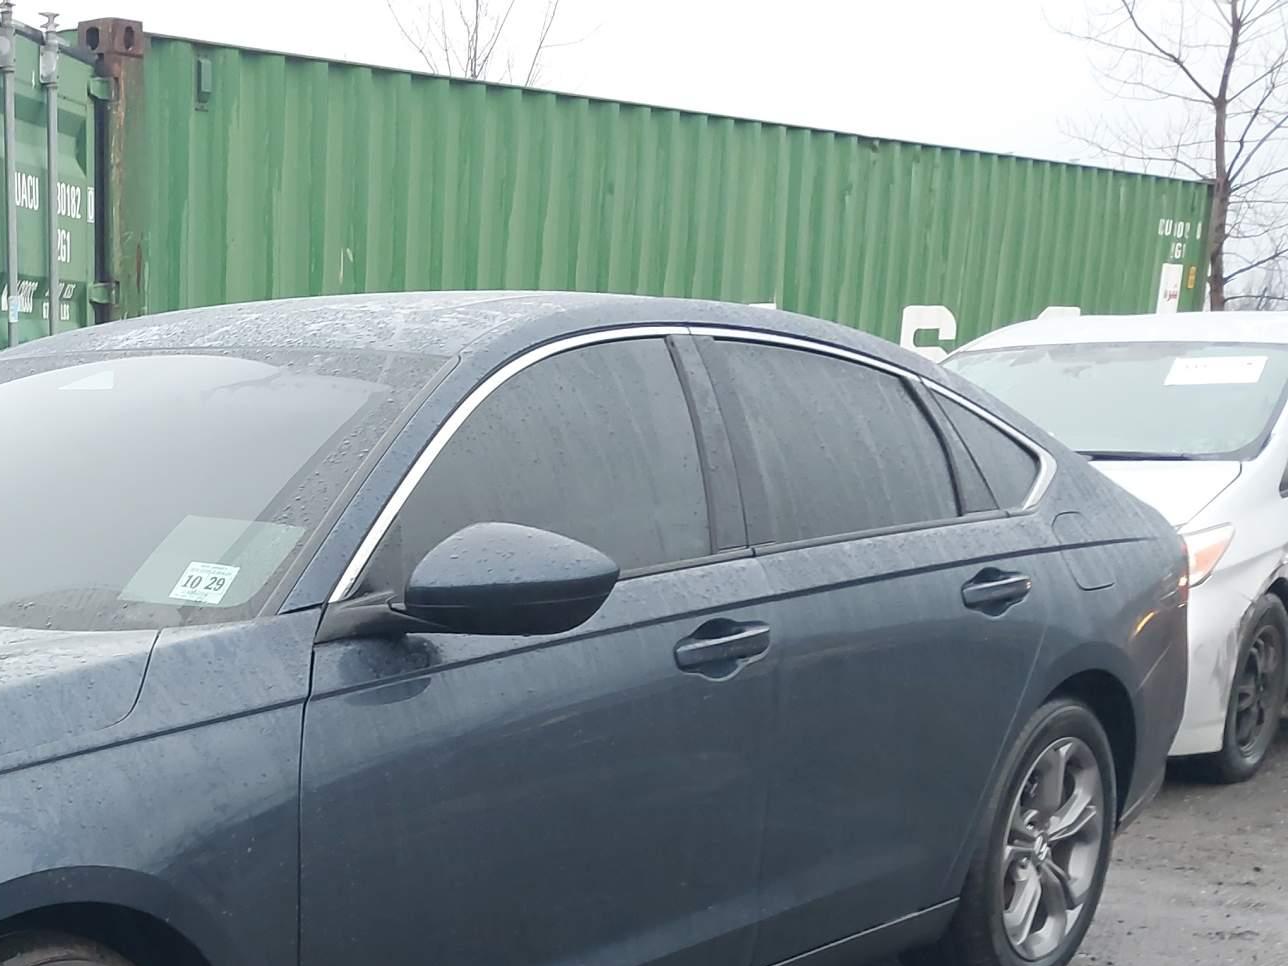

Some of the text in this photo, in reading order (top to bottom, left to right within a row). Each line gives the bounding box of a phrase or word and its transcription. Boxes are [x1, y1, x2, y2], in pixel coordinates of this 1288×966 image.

[14, 171, 40, 211] UACU
[181, 574, 226, 592] 10 29
